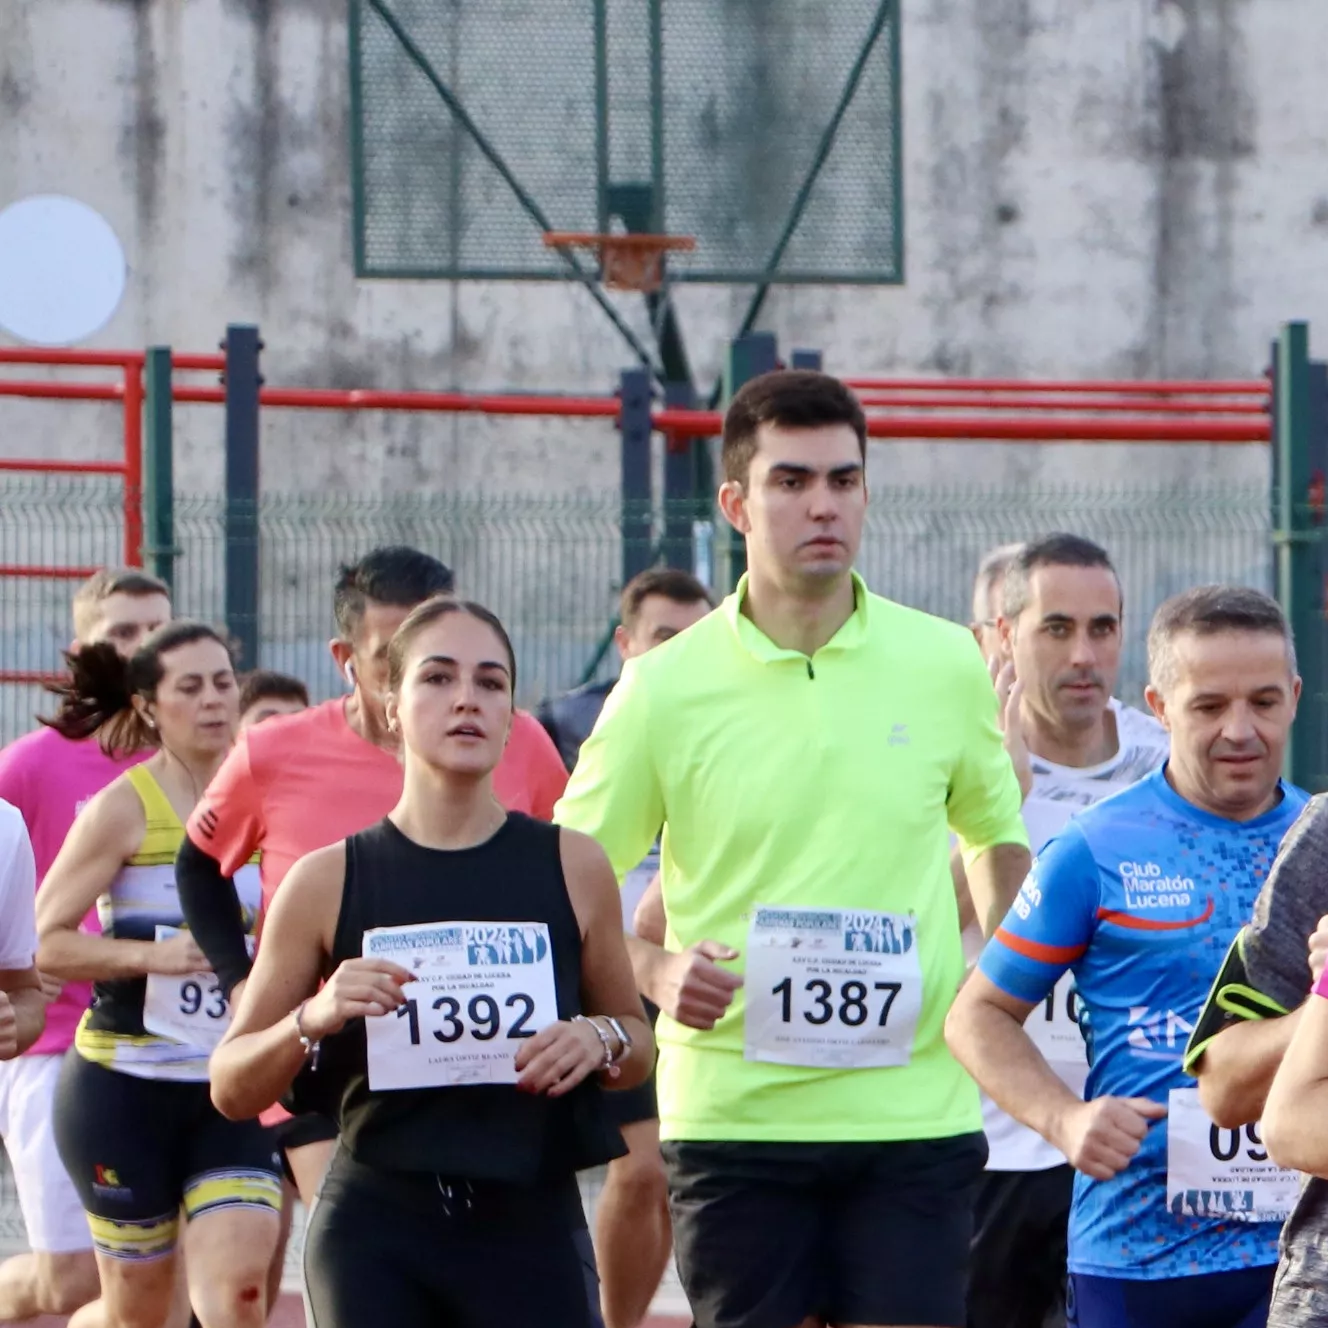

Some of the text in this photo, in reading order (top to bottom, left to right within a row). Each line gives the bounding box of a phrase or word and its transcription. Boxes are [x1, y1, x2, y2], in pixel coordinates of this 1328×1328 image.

[1119, 862, 1160, 878] Club
[1122, 874, 1194, 893] Maratón
[1125, 893, 1191, 909] Lucena
[844, 914, 884, 931] 2024
[465, 926, 511, 946] 2024
[772, 977, 903, 1027] 1387
[397, 992, 537, 1045] 1392
